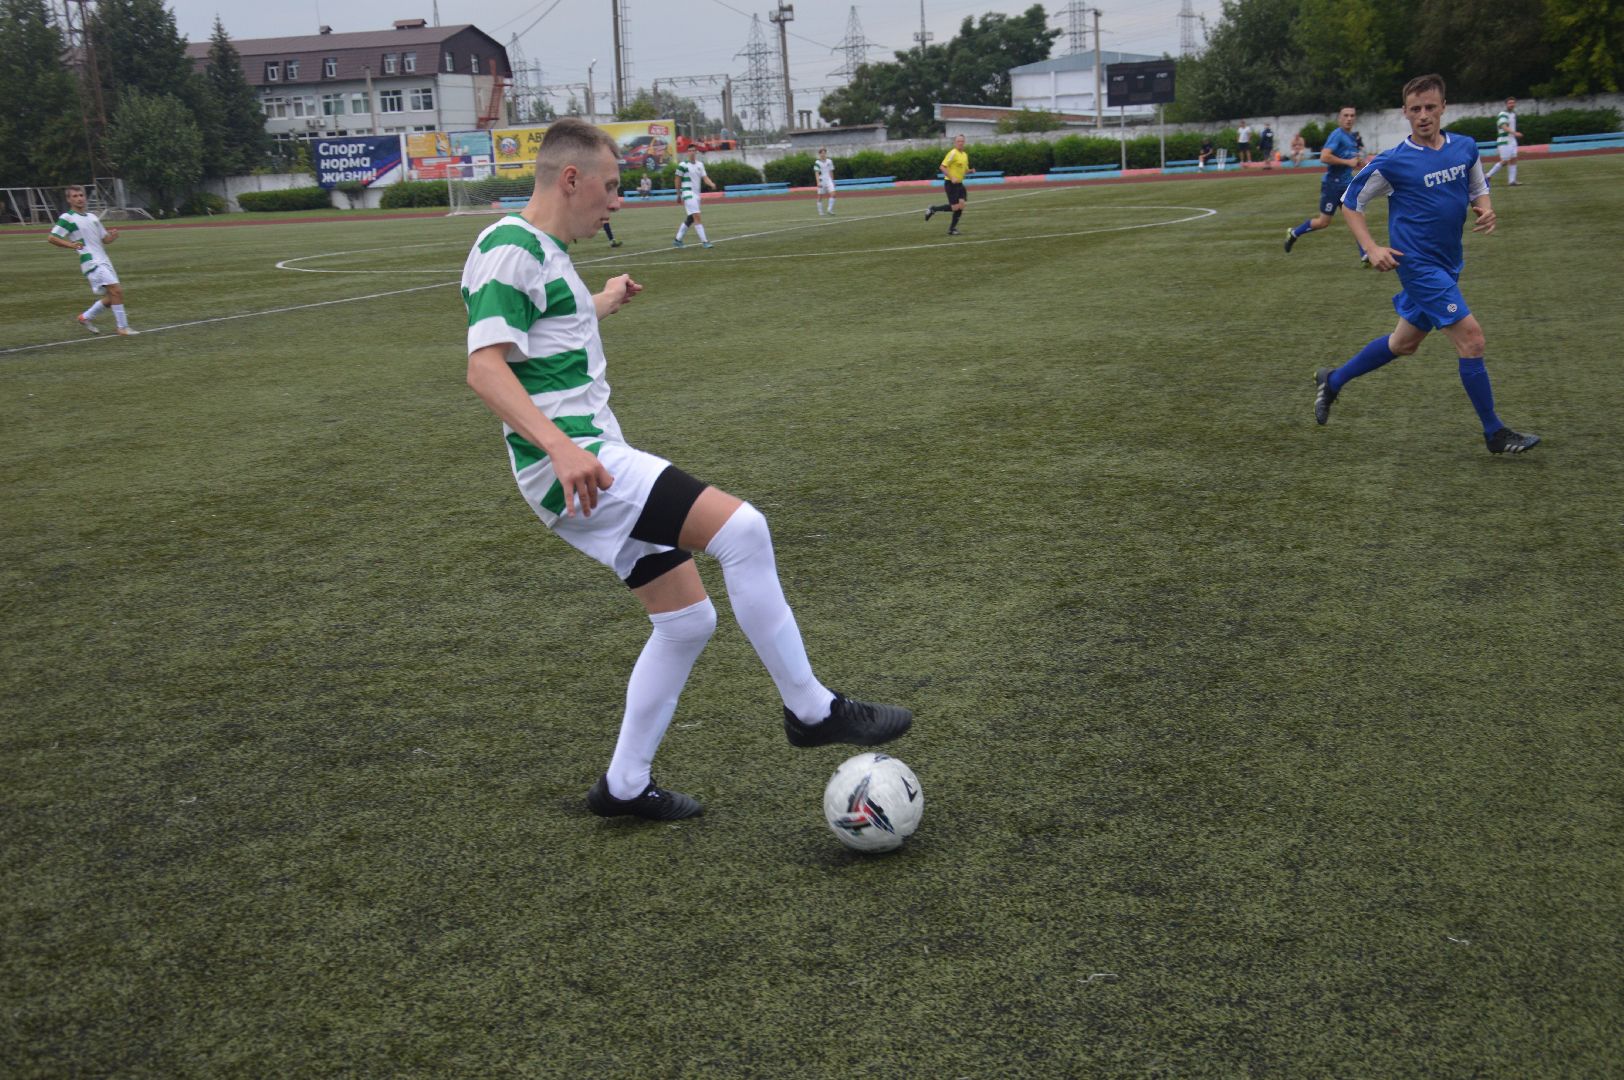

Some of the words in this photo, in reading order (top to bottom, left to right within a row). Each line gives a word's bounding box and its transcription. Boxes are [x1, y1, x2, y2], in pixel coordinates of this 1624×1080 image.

[318, 142, 366, 157] Спорт
[320, 156, 371, 172] норма
[321, 168, 377, 183] жизни!
[1423, 163, 1466, 188] СТАРТ
[1325, 202, 1333, 212] 9
